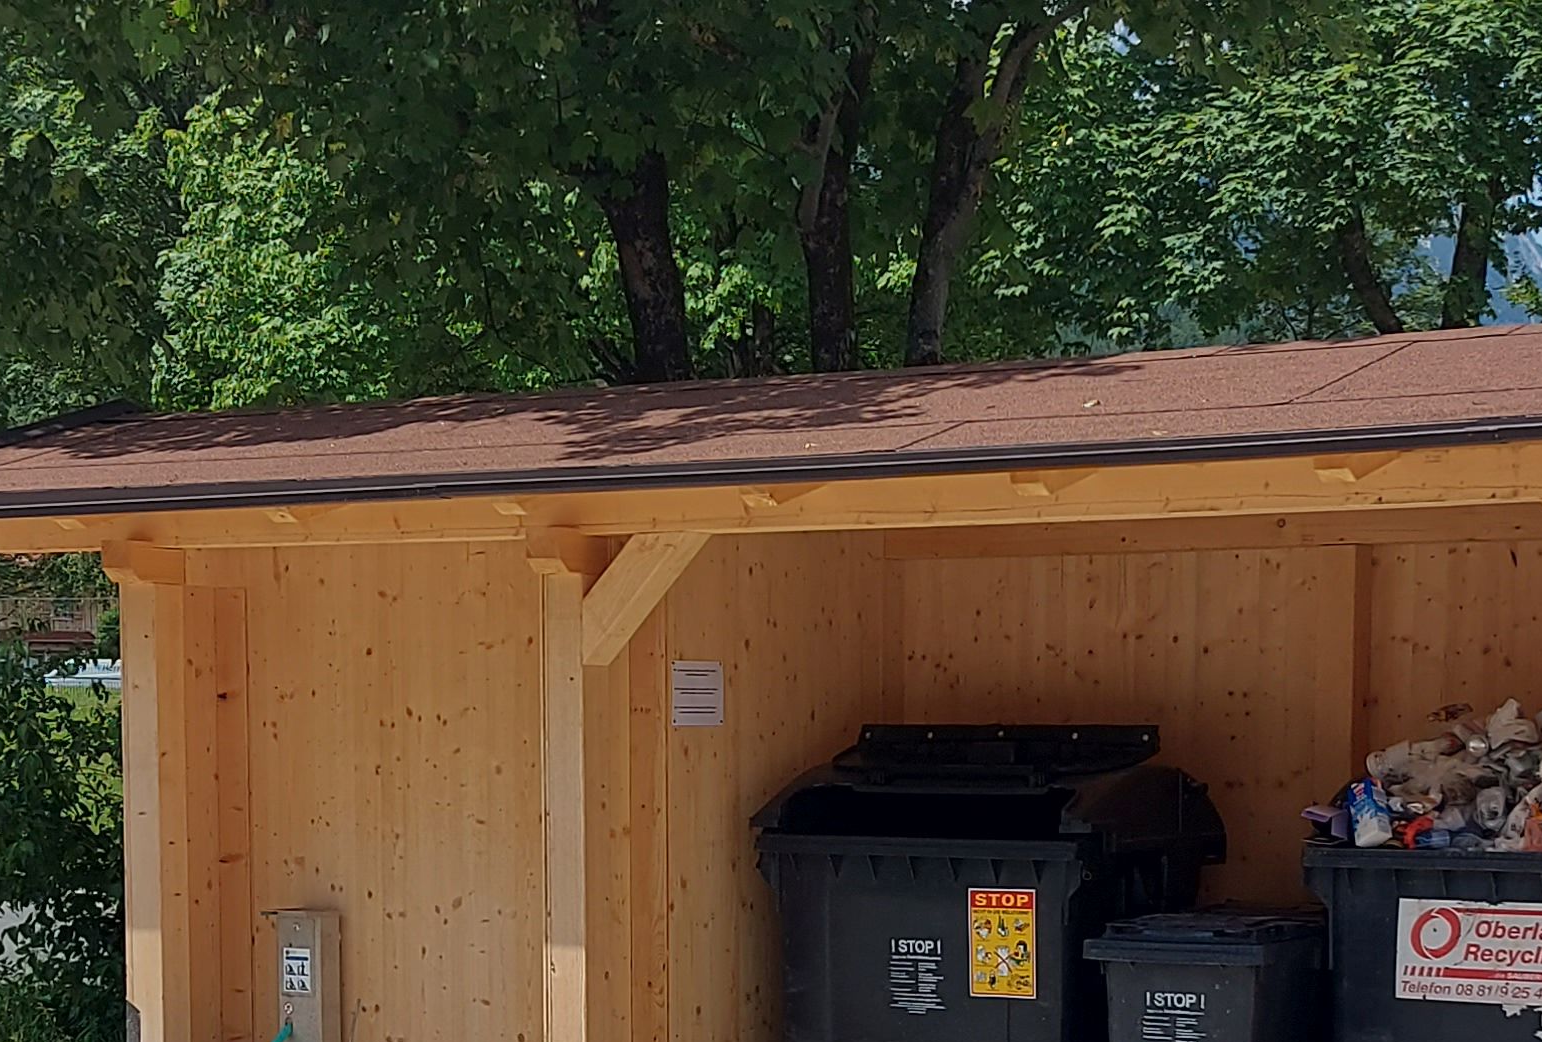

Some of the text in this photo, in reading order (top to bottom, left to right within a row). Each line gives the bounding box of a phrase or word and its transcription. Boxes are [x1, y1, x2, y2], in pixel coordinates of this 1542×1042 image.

[975, 893, 1029, 907] STOP
[898, 939, 934, 954] STOP
[1401, 980, 1451, 996] Telefon
[1455, 983, 1473, 996] 08
[1512, 986, 1531, 1000] 25
[1153, 992, 1197, 1008] STOP
